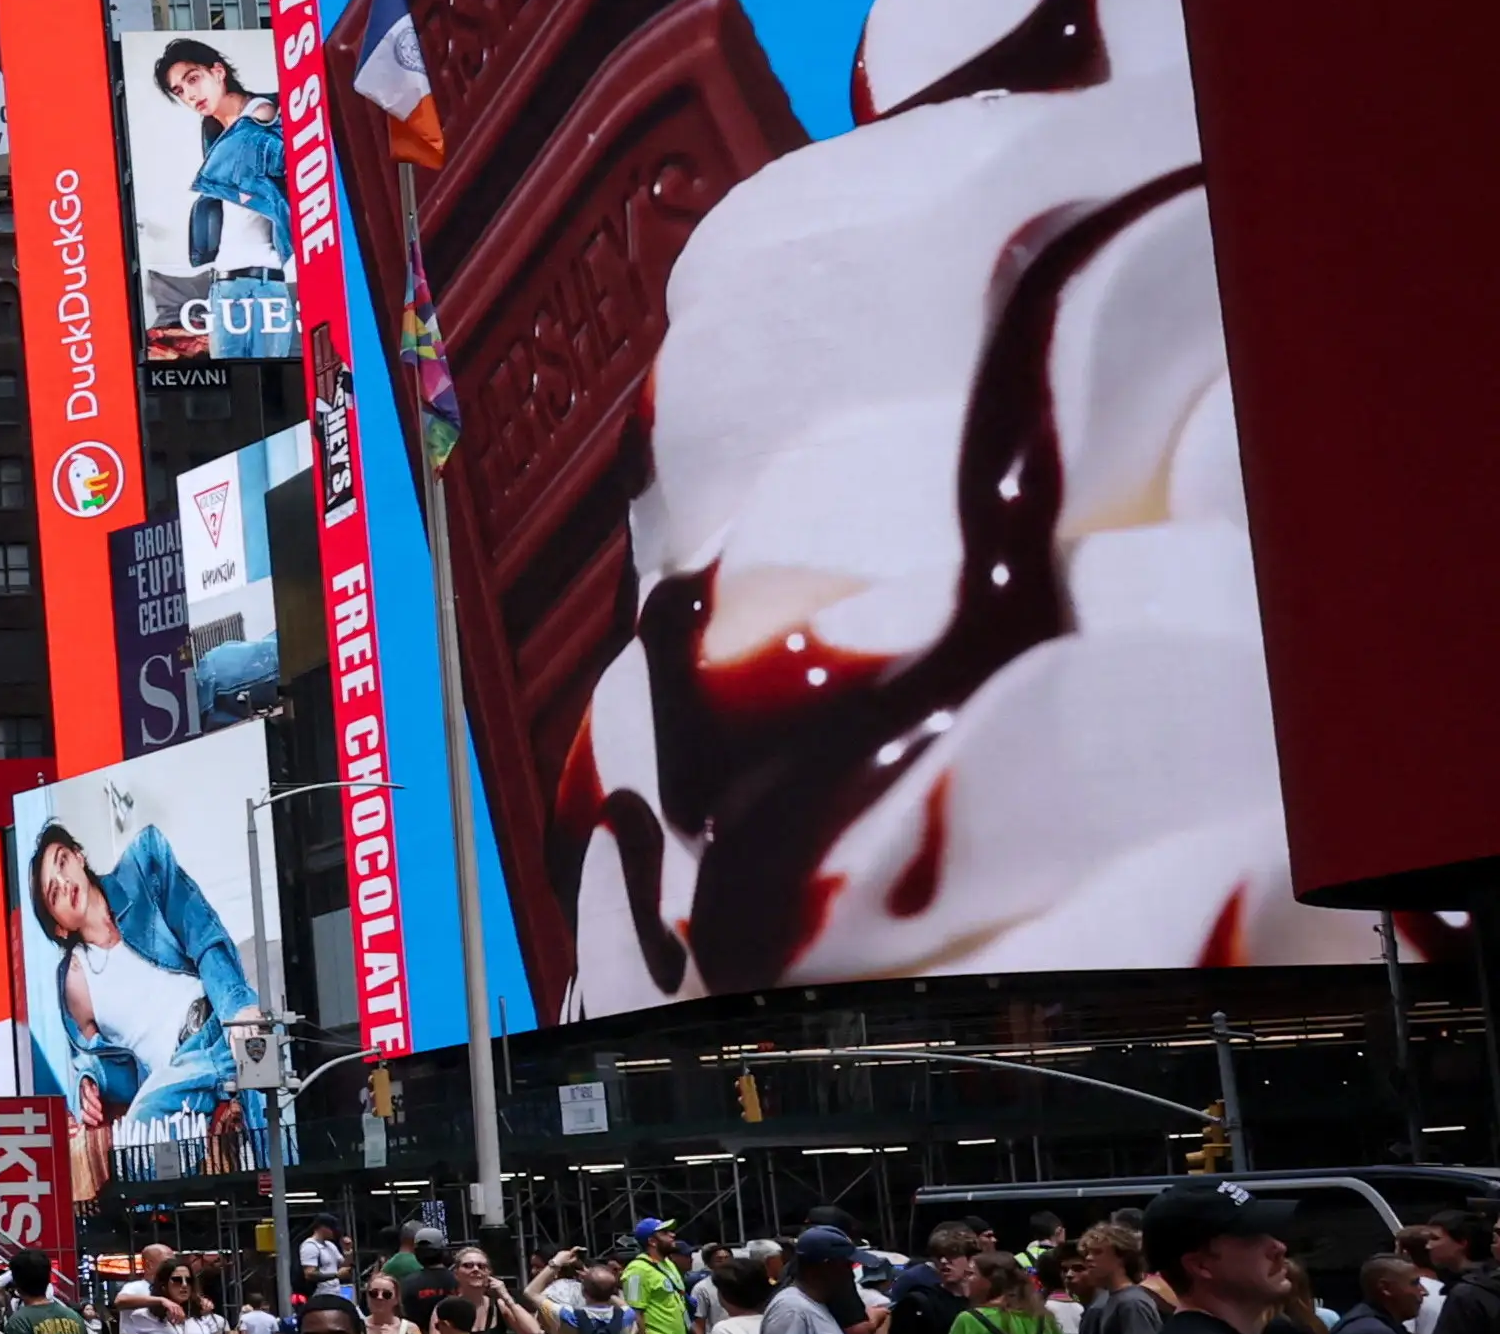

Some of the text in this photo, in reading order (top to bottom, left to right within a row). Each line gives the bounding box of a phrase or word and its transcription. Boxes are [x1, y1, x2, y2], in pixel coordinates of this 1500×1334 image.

[50, 168, 99, 422] DuckDuckGo
[287, 78, 335, 267] STORE
[331, 562, 406, 1052] FREE CHOCOLATE
